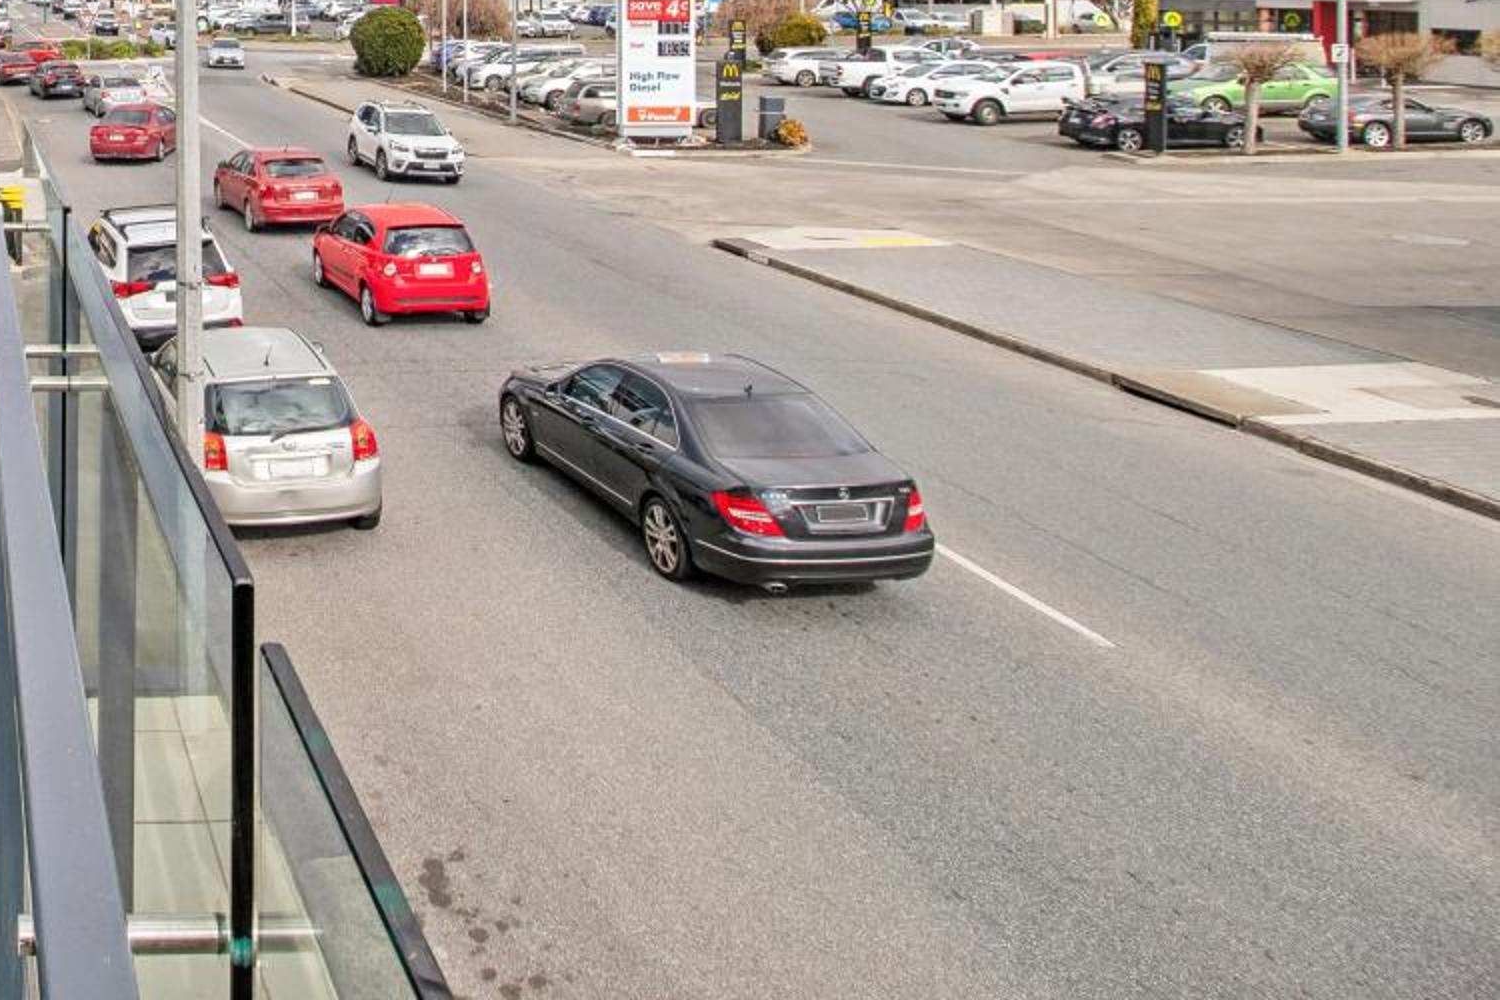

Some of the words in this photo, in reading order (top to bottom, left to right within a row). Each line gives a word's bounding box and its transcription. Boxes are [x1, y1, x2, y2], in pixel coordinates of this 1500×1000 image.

[629, 1, 662, 11] save
[629, 71, 655, 82] High
[657, 71, 680, 80] Flow
[629, 82, 661, 92] Diesel
